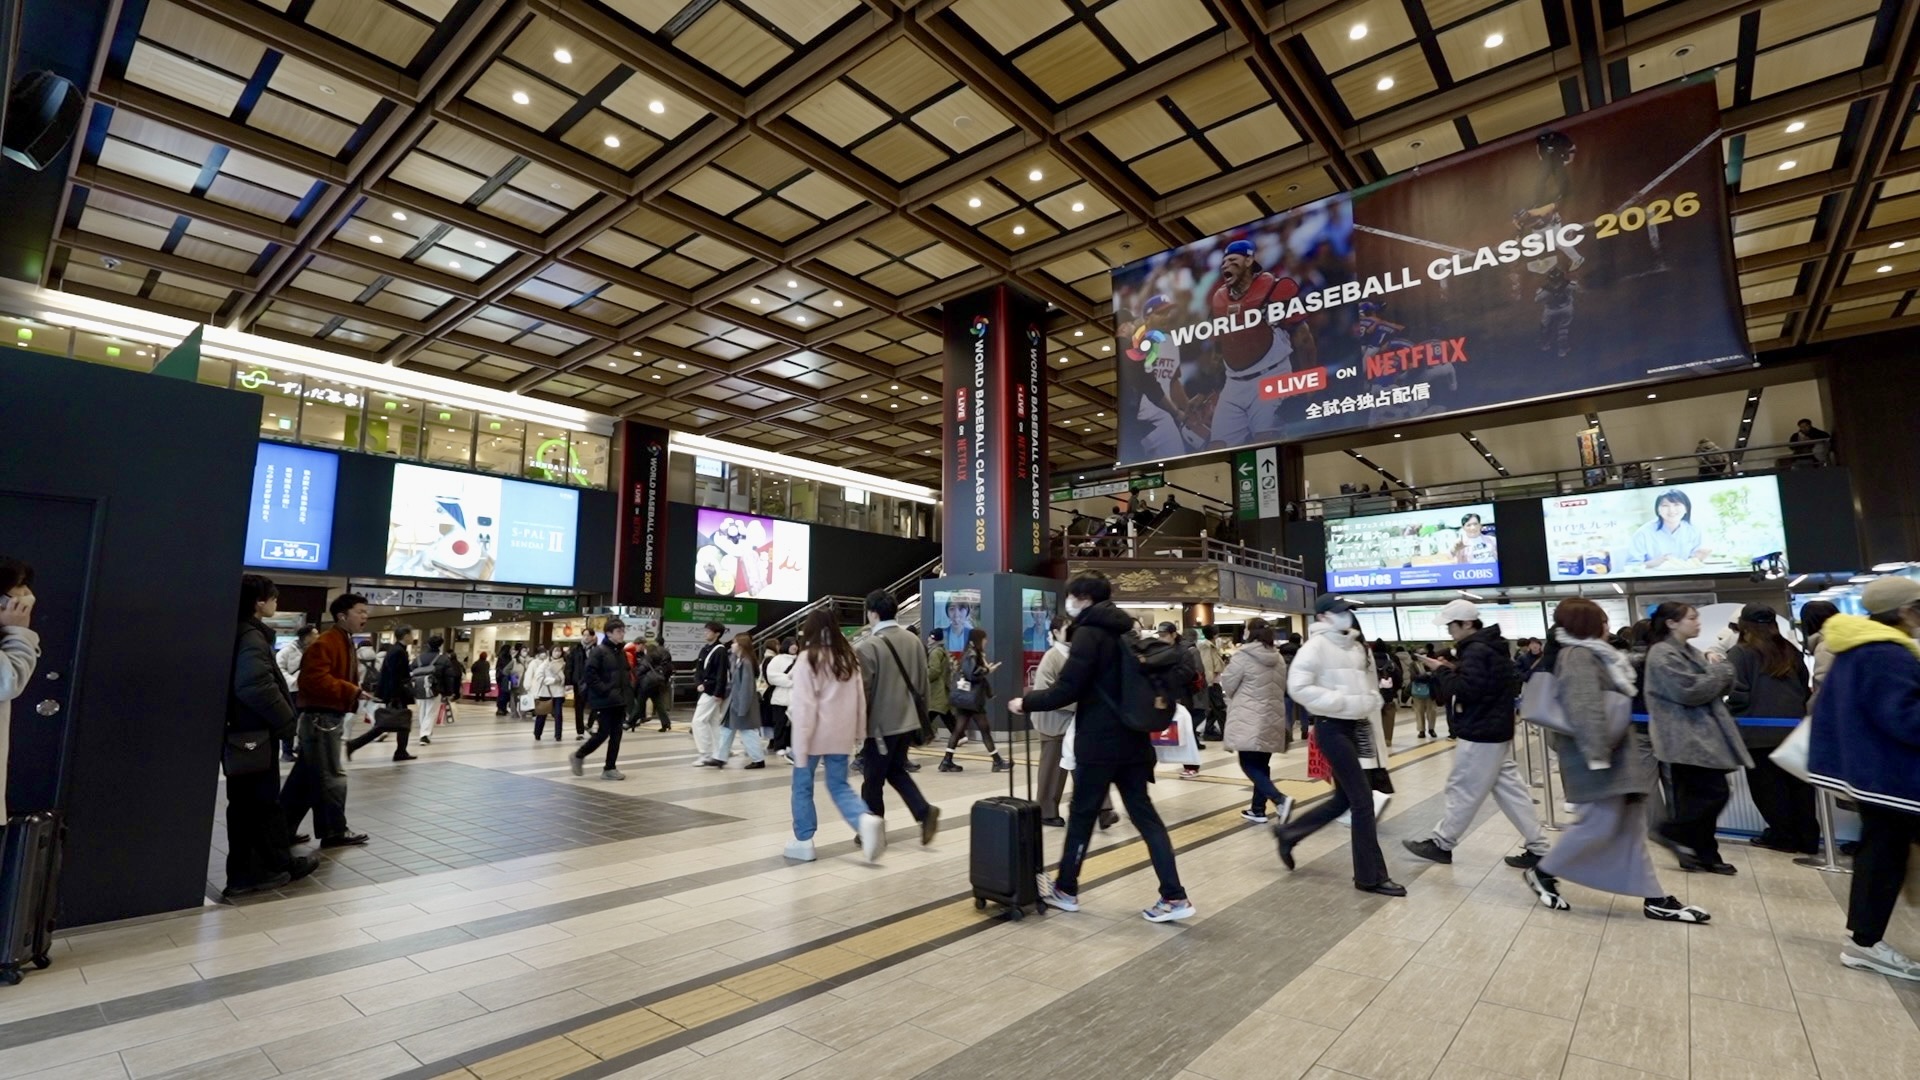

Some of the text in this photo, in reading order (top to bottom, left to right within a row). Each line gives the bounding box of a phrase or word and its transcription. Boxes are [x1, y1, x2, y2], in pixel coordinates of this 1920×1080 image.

[1171, 191, 1701, 347] WORLD BASEBALL CLASSIC 2026
[1277, 337, 1467, 396] LIVE ON NETFLIX
[1306, 383, 1430, 420] 全試合独占配信
[956, 397, 967, 482] LIVE ON NETFLIX
[974, 341, 985, 552] WORLD BASEBALL CLASSIC 2026
[1017, 435, 1026, 479] NETFLIX
[1030, 348, 1040, 554] WORLD BASEBALL CLASSIC 2026
[511, 540, 544, 550] SENDAI
[512, 527, 544, 539] S-PAL
[643, 457, 658, 594] WORLD BASEBALL CLASSIC 2026
[1452, 568, 1494, 580] GLOBIS
